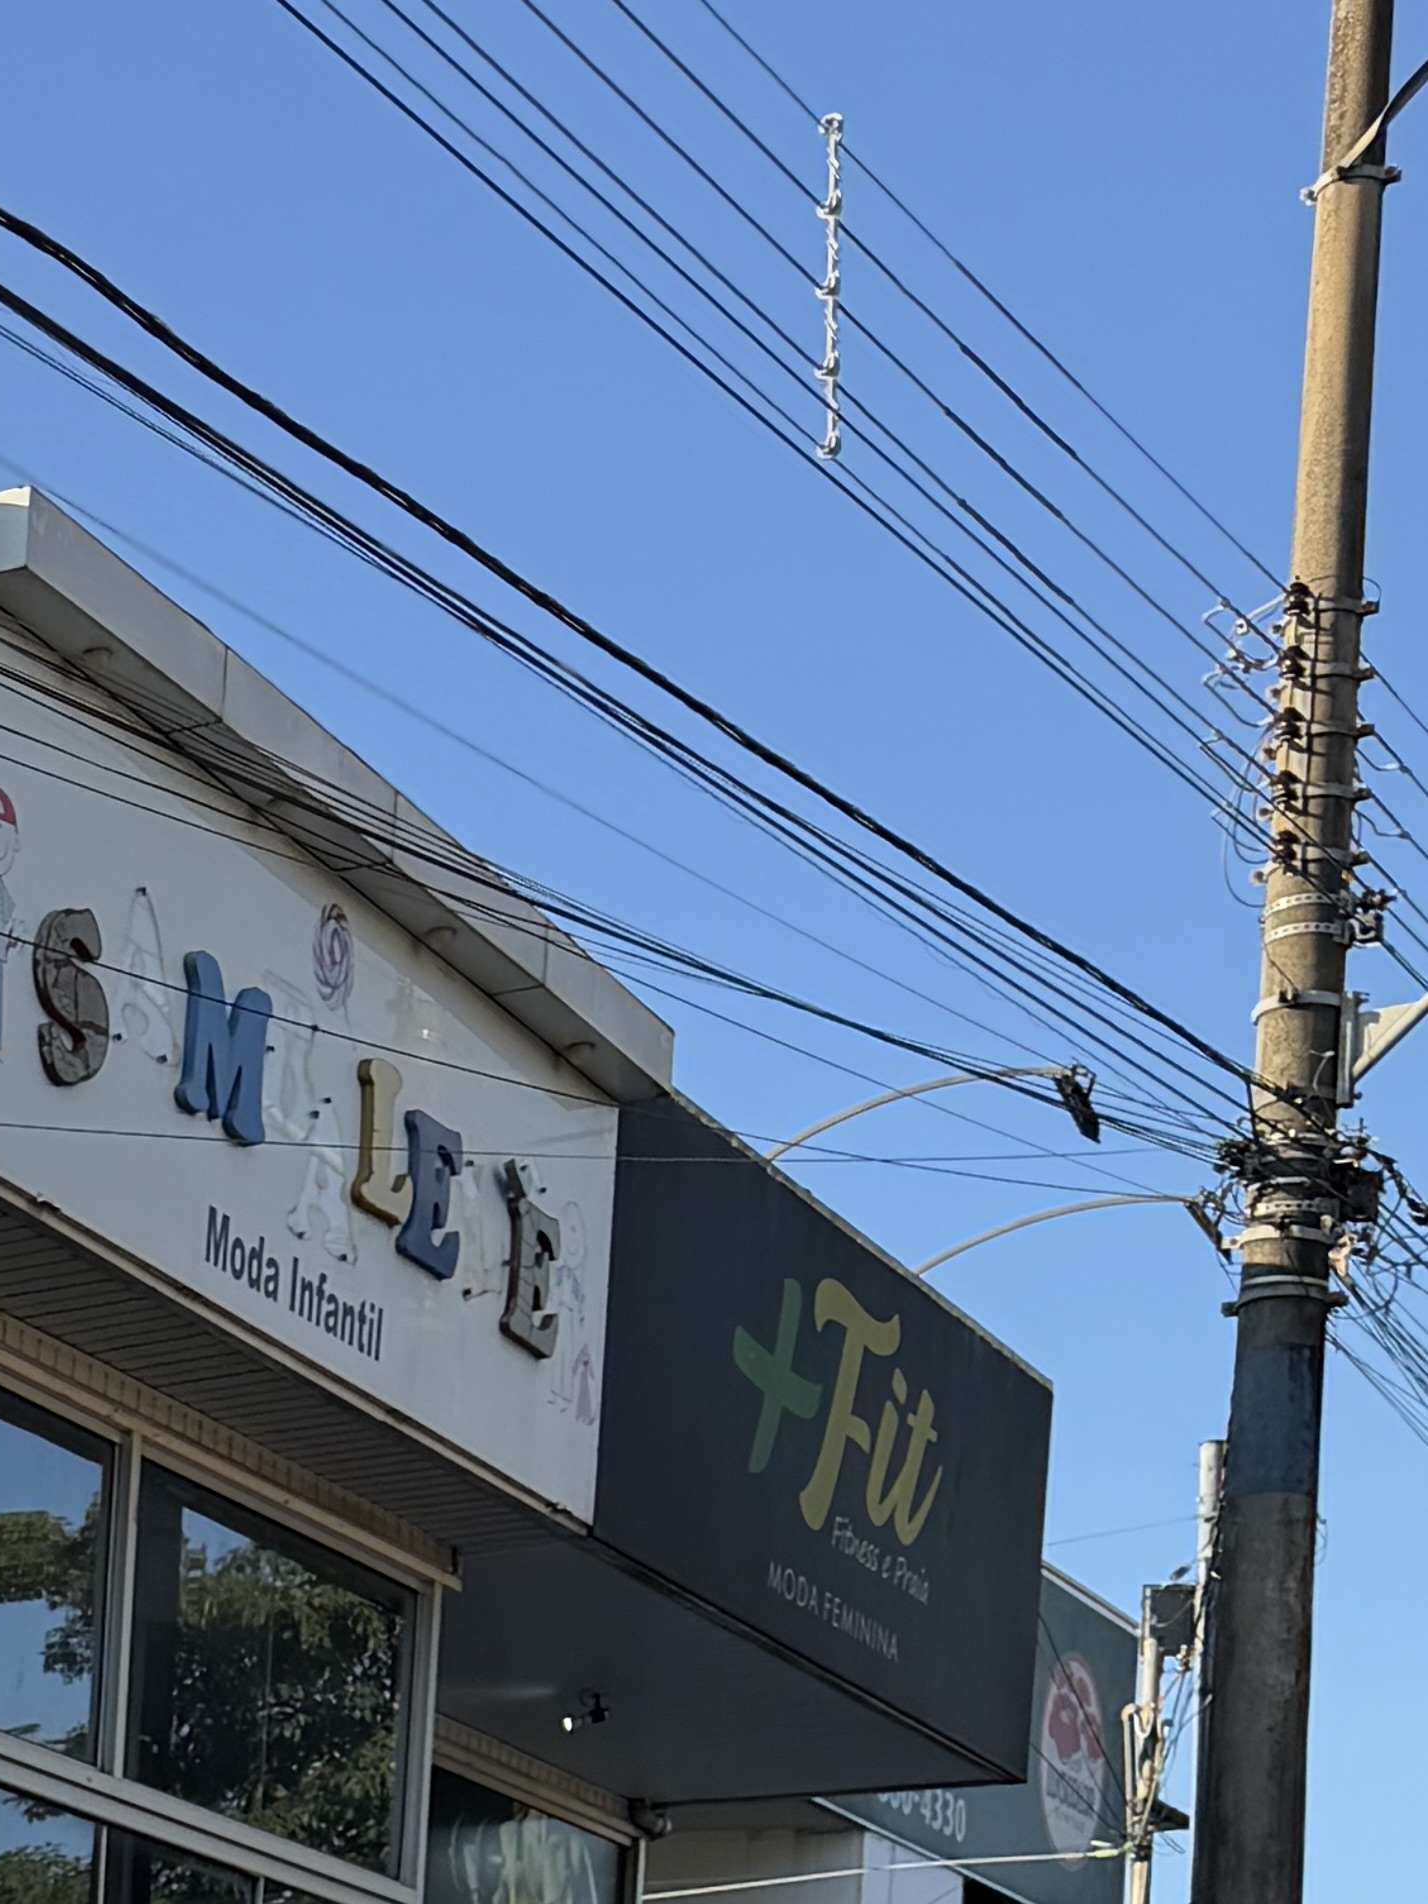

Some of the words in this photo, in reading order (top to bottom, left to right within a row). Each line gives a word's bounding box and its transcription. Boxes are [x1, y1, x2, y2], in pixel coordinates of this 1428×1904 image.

[205, 1204, 280, 1303] Moda
[289, 1255, 384, 1361] Infantil
[768, 1561, 819, 1616] MODA
[823, 1591, 899, 1663] FEMININA
